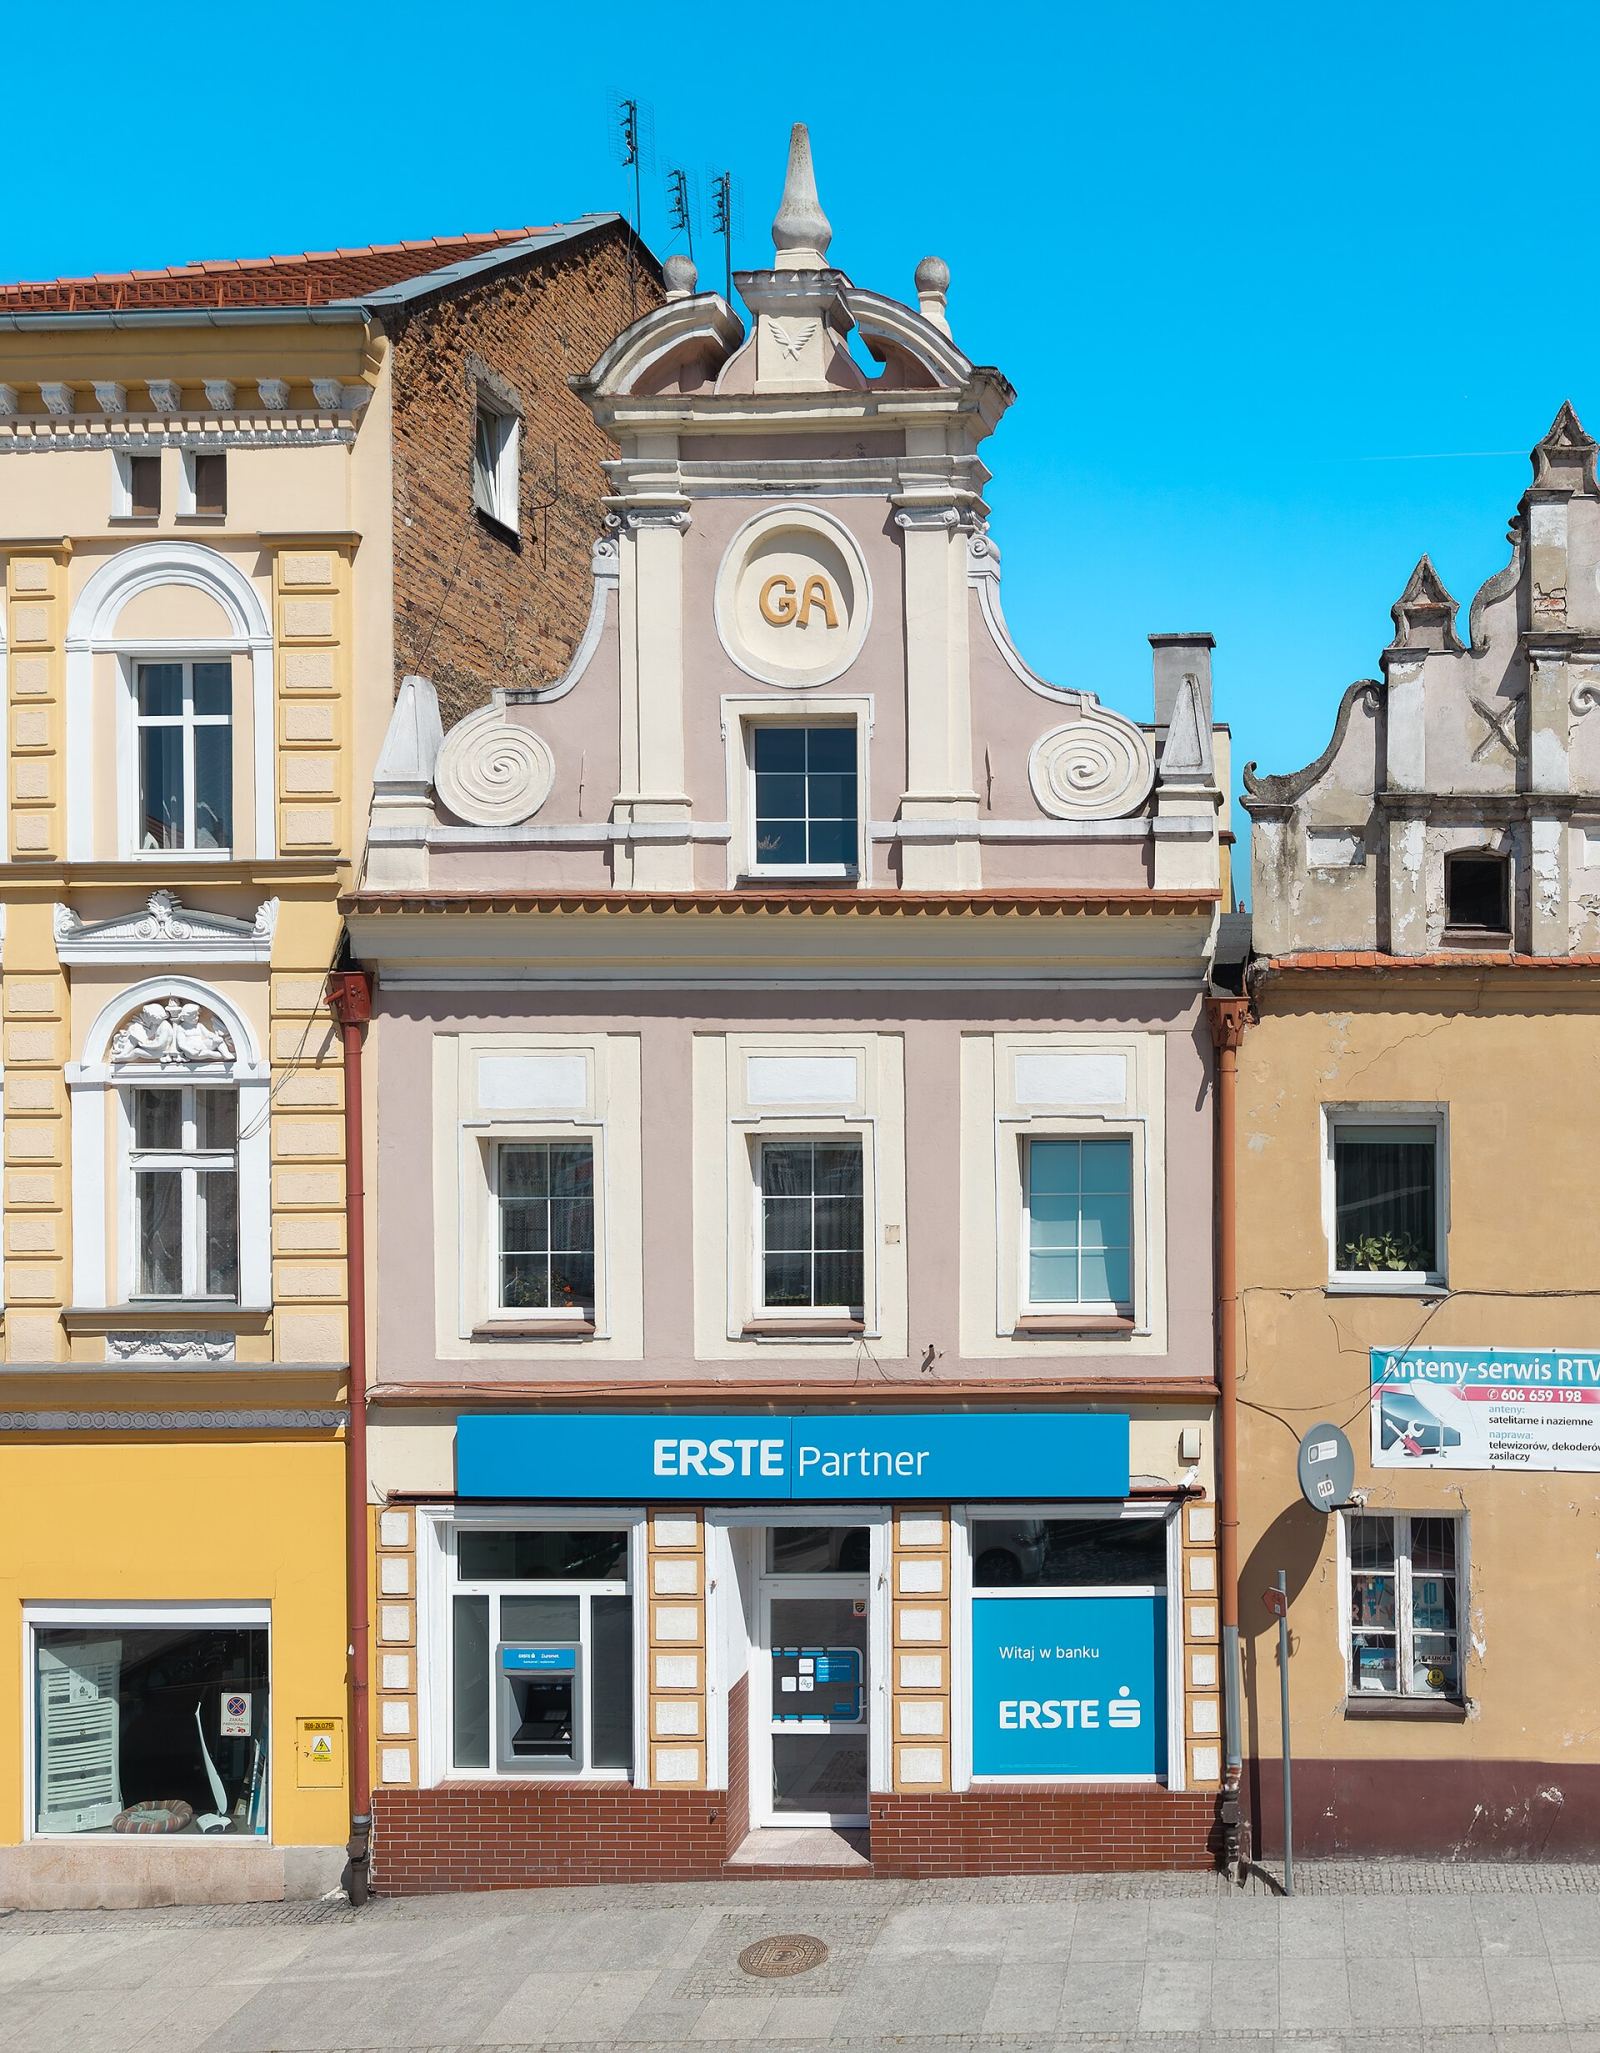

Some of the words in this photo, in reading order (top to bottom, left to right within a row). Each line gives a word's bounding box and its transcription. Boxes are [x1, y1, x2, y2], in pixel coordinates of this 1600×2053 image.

[760, 574, 839, 629] GA
[1382, 1356, 1552, 1384] Anteny-serwis
[1501, 1389, 1525, 1401] 606
[1529, 1390, 1553, 1402] 659
[1558, 1391, 1582, 1402] 198
[1489, 1406, 1525, 1414] anteny:
[1489, 1415, 1539, 1425] satelitarne
[1546, 1417, 1594, 1426] naziemne
[1489, 1432, 1534, 1440] naprawa:
[1489, 1441, 1550, 1452] telewizorów,
[653, 1439, 784, 1476] ERSTE
[798, 1446, 930, 1477] Partner
[1489, 1452, 1531, 1462] zasilaczy
[1318, 1481, 1333, 1496] HD
[999, 1646, 1035, 1661] Witaj
[1040, 1649, 1051, 1658] w
[1056, 1646, 1100, 1659] banku
[999, 1700, 1100, 1729] ERSTE
